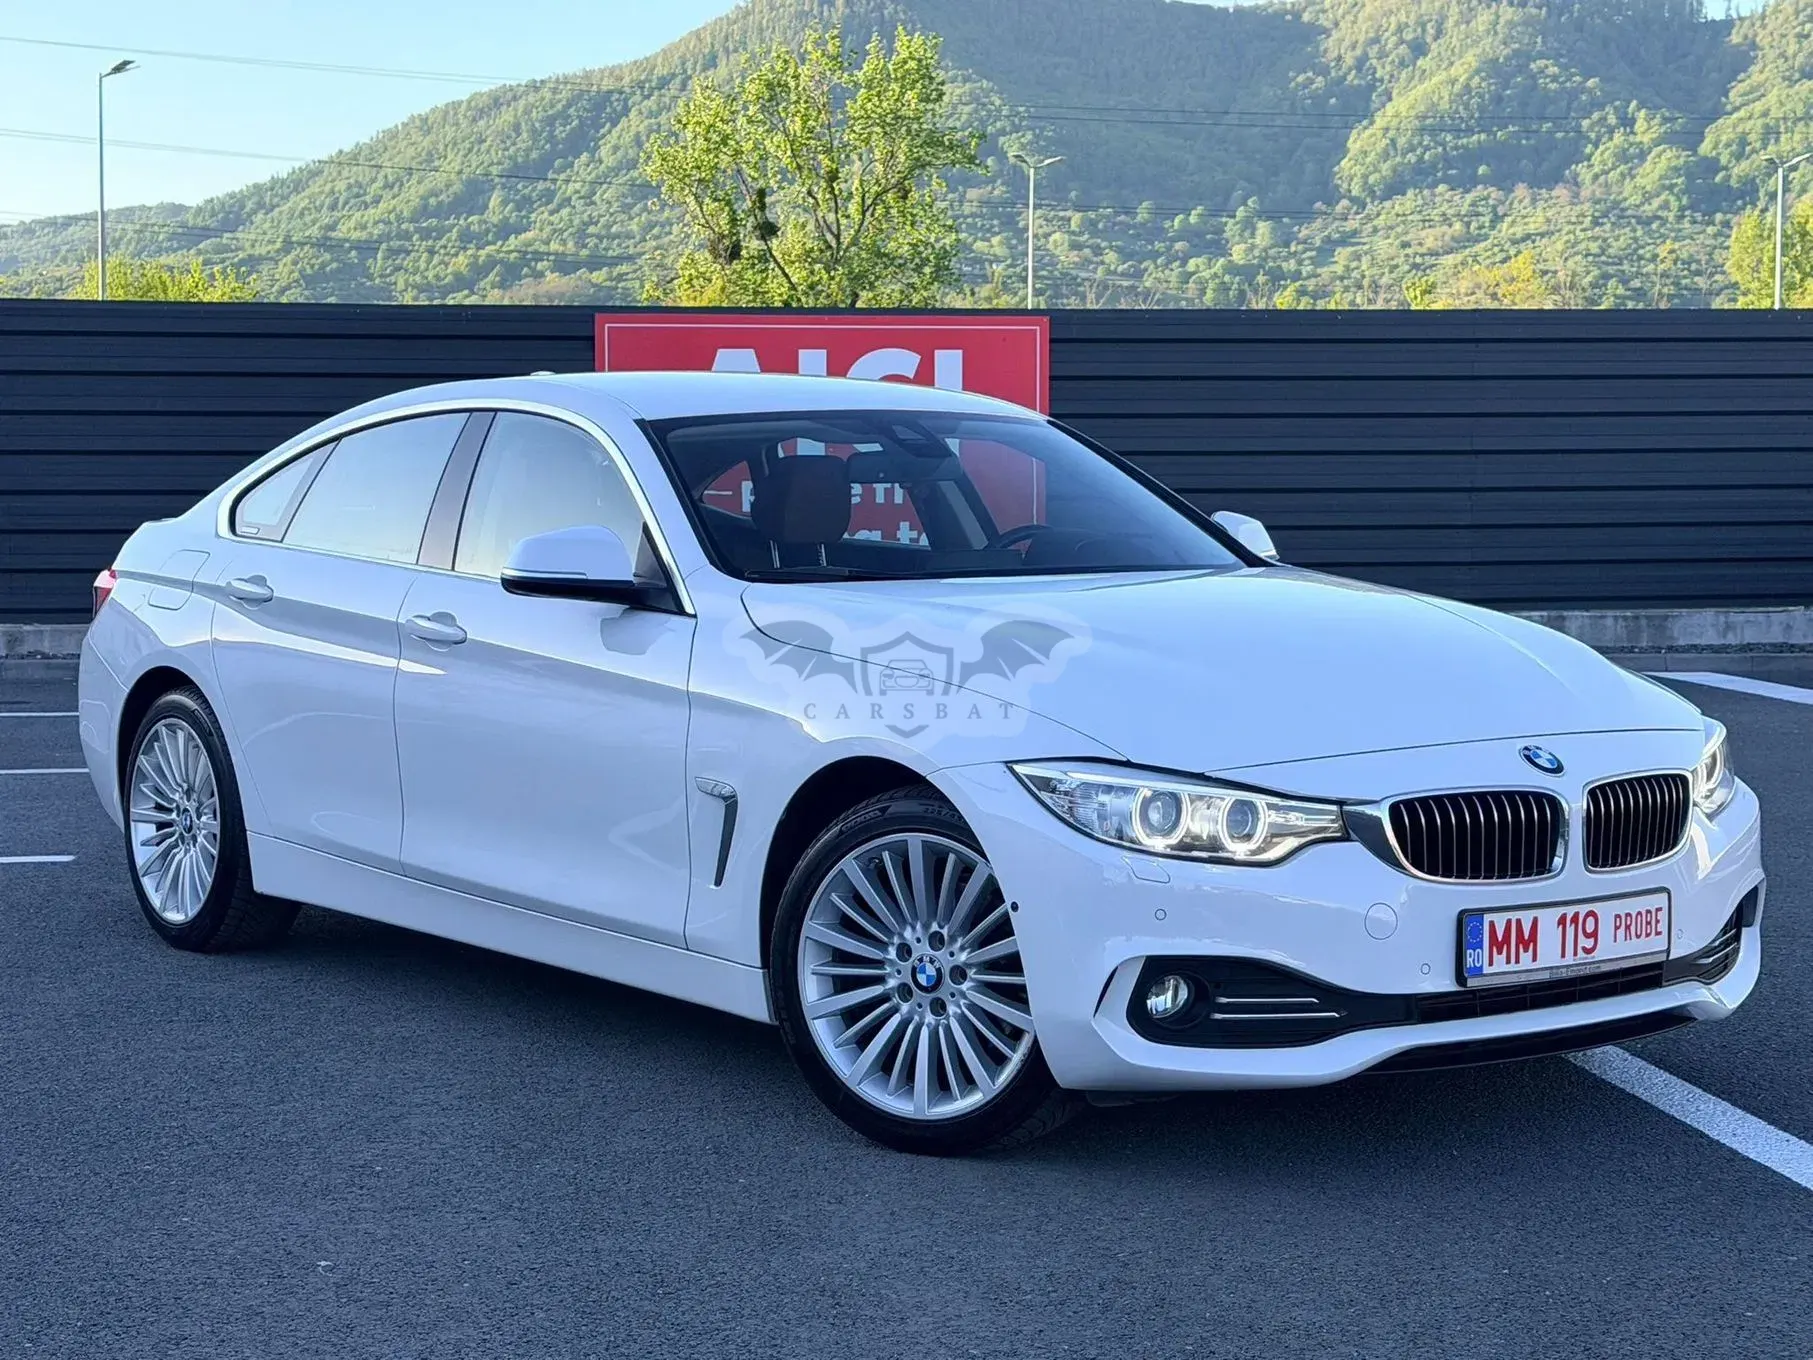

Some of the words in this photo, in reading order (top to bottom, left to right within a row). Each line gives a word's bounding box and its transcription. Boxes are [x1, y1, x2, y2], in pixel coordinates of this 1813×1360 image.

[1488, 916, 1539, 967] MM
[1557, 909, 1599, 959] 119
[1613, 907, 1663, 943] PROBE
[1467, 949, 1482, 968] RO
